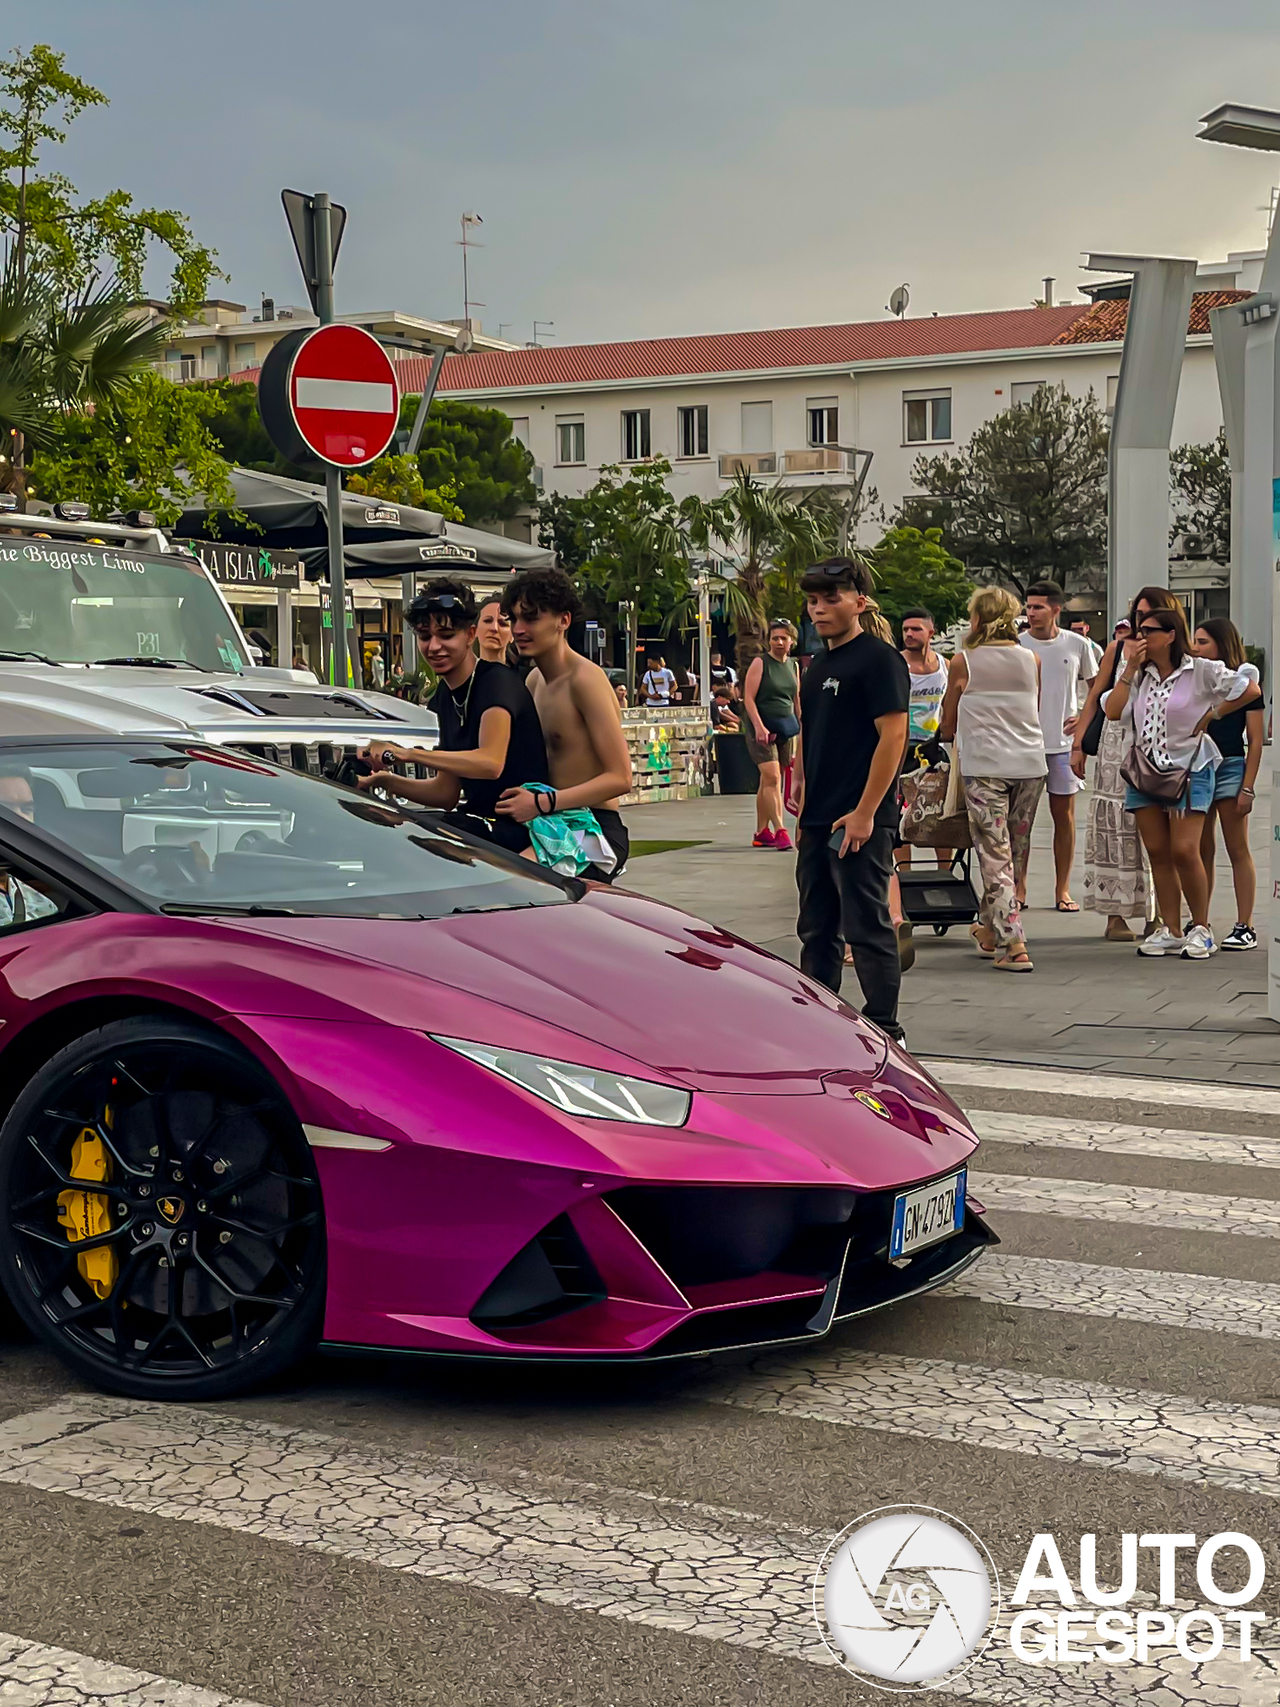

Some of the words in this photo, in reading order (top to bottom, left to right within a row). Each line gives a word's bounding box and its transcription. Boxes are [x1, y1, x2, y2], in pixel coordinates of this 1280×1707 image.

[23, 545, 97, 570] Biggest
[102, 552, 145, 574] Limo
[225, 551, 256, 580] ISLA
[136, 632, 162, 654] P31
